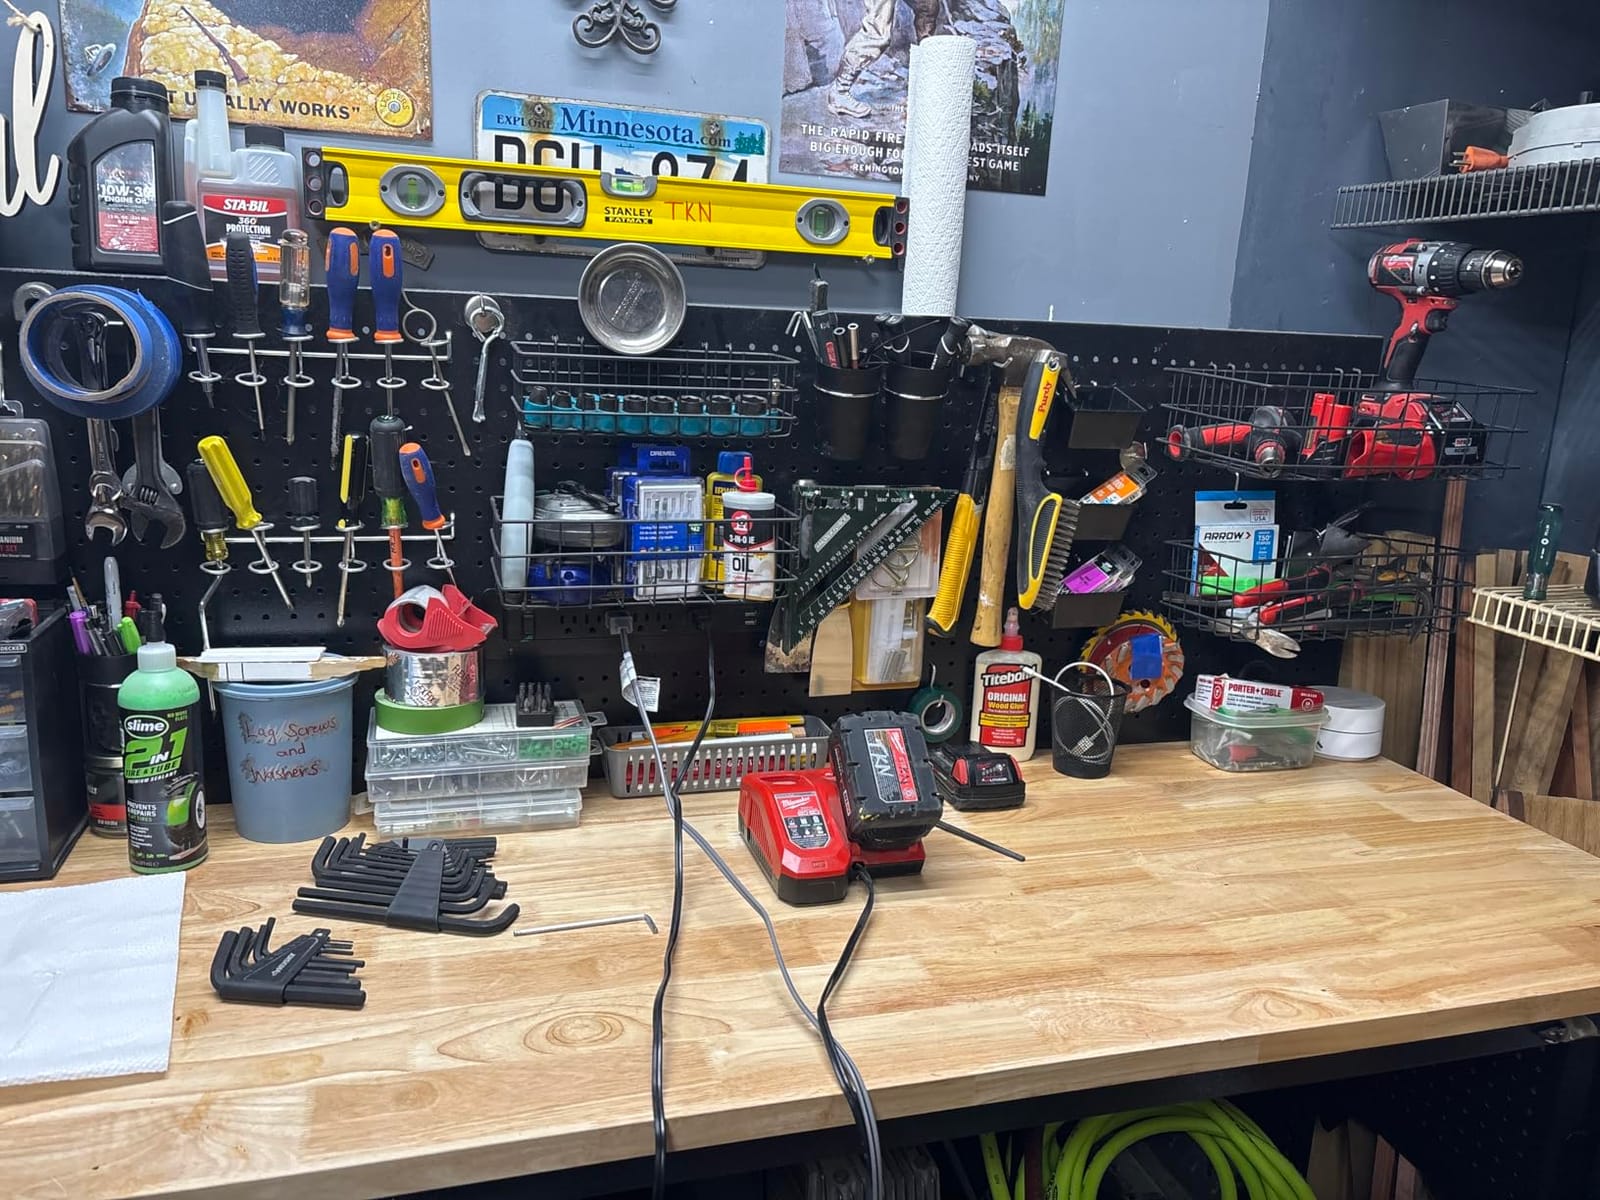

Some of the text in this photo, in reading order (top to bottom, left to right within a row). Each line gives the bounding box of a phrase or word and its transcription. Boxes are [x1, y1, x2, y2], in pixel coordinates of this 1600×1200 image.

[184, 91, 271, 112] UALLY
[496, 114, 552, 129] EXPLORE
[801, 124, 1030, 157] THE RAPID FIRE ADS ITSELF
[810, 141, 832, 152] BIG
[835, 143, 883, 158] ENOUGH
[886, 148, 905, 159] FO
[988, 158, 1019, 171] GAME
[104, 195, 150, 205] ENGINE OIL
[604, 206, 653, 217] STANLEY
[664, 200, 712, 223] TKN
[609, 216, 650, 224] FATMAX
[225, 223, 272, 235] PROTECTION
[1038, 380, 1052, 413] Purdy
[0, 536, 23, 544] ANIUM
[1203, 531, 1245, 541] ARROW
[732, 557, 754, 573] OIL
[987, 691, 1027, 703] ORIGINAL
[988, 702, 1025, 710] Wood Glue
[127, 719, 165, 732] slime
[243, 716, 337, 746] Lag Screws
[149, 751, 170, 765] IN
[169, 727, 188, 759] 1
[276, 742, 306, 757] and
[867, 738, 895, 777] TKN
[150, 760, 177, 774] TUBE
